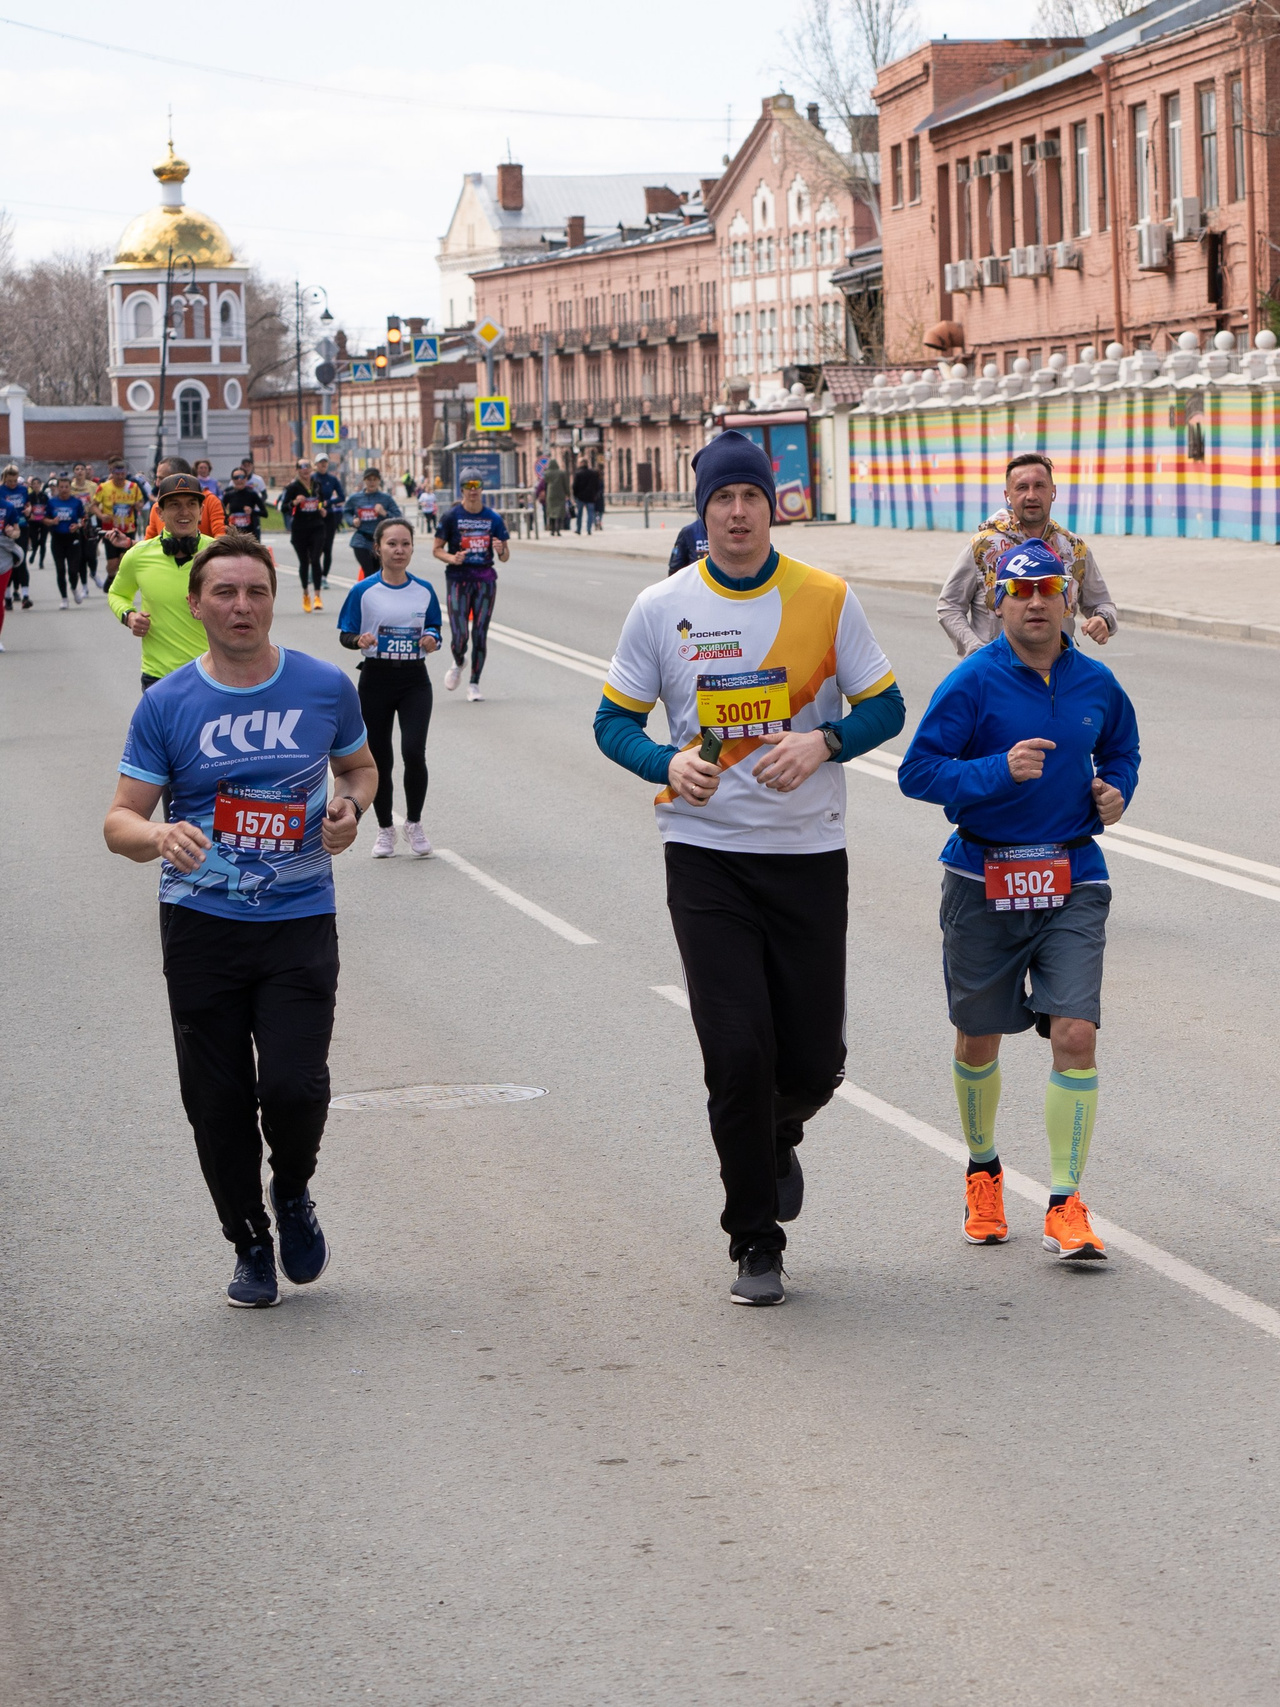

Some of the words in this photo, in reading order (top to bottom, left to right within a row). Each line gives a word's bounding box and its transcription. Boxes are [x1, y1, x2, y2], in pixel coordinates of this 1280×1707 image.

[690, 630, 742, 638] РОСНЕФТЬ
[387, 640, 412, 652] 2155
[700, 642, 737, 652] ЖИВИТЕ
[698, 650, 740, 660] ДОЛЬШЕ!
[728, 674, 758, 682] ПРОСТО
[716, 699, 771, 724] 30017
[200, 710, 303, 758] ССК
[211, 758, 249, 768] «Самарская
[250, 754, 276, 762] сетевая
[236, 810, 286, 836] 1576
[1004, 870, 1055, 895] 1502
